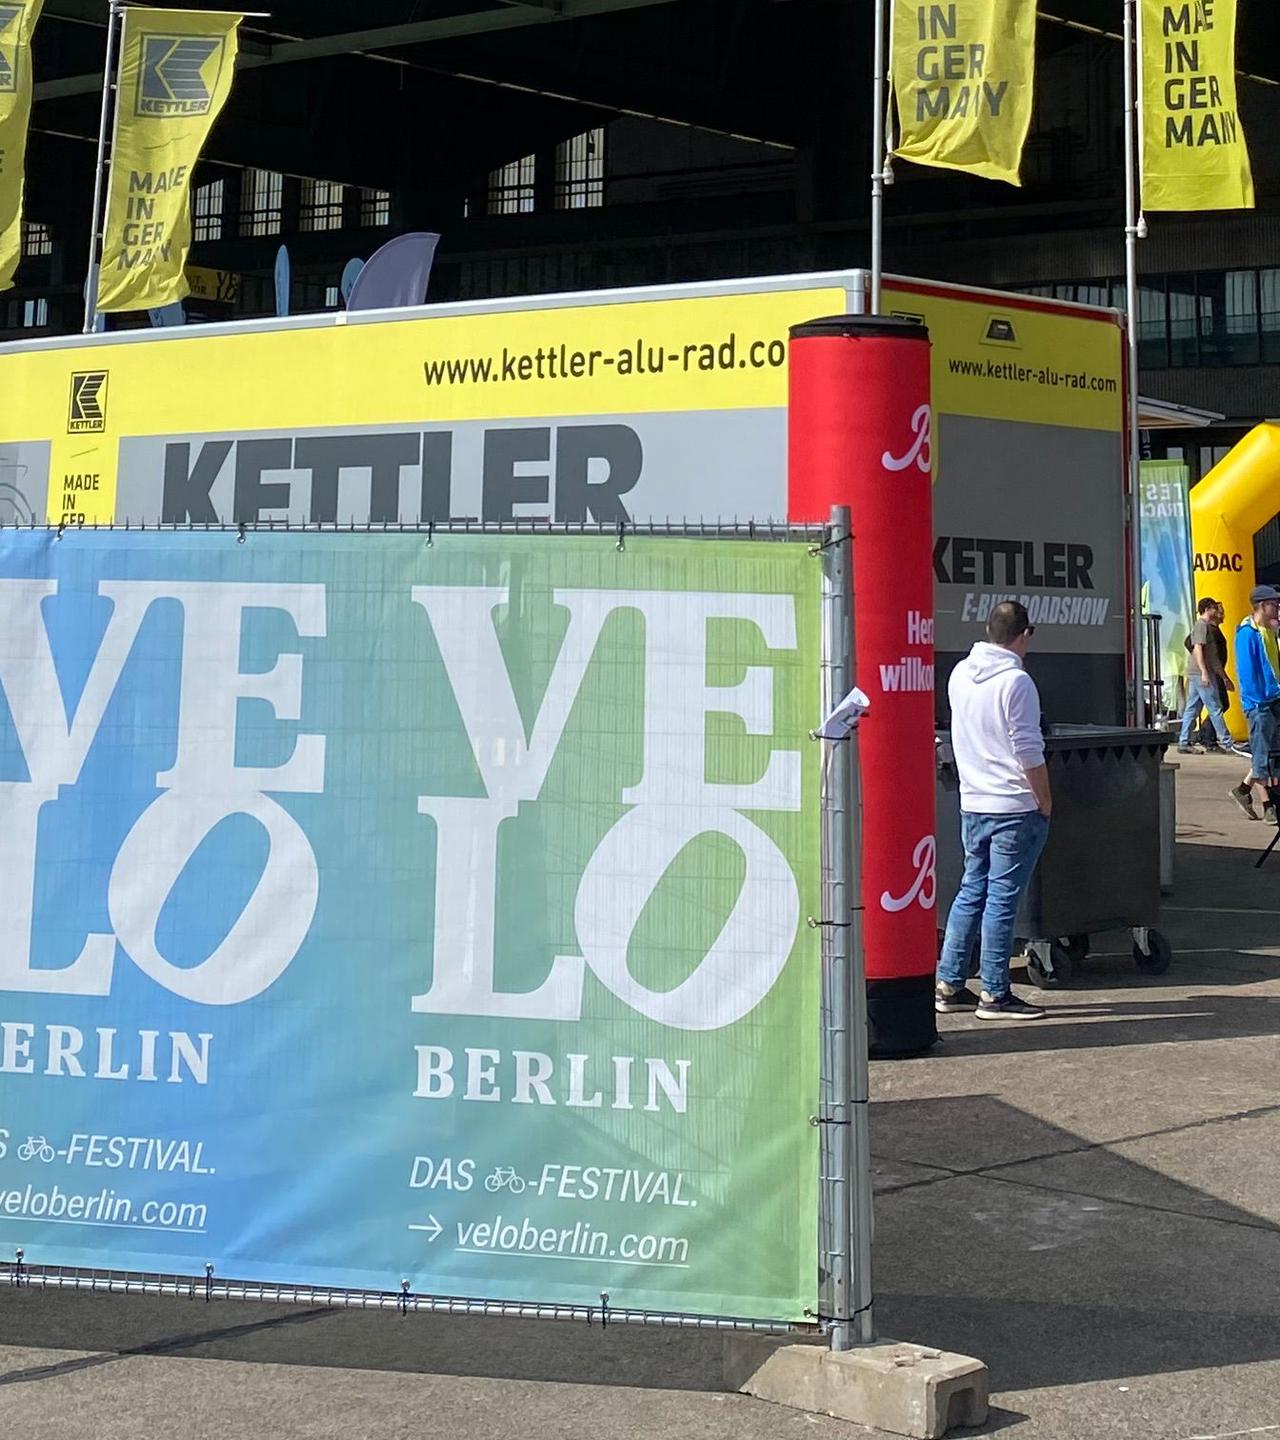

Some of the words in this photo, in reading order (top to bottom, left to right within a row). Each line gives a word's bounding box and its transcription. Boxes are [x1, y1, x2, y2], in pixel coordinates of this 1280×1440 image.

[918, 4, 956, 40] IN
[916, 44, 984, 81] GER
[1164, 40, 1198, 74] IN
[141, 98, 208, 113] KETTLER
[1163, 75, 1222, 110] GER
[126, 197, 156, 220] IN
[122, 222, 164, 246] GER
[424, 333, 786, 388] www.kettler-alu-rad.co
[948, 357, 1118, 394] www.kettler-alu-rad.com
[70, 421, 104, 430] KETTLER
[63, 474, 100, 490] MADE
[161, 423, 644, 524] KETTLER
[62, 494, 76, 510] IN
[932, 536, 1094, 589] KETTLER
[1193, 553, 1243, 573] ADAC
[411, 584, 801, 812] VE
[411, 795, 800, 1030] LO
[411, 1045, 691, 1113] BERLIN
[410, 1156, 475, 1192] DAS
[455, 1214, 690, 1261] veloberlin.com
